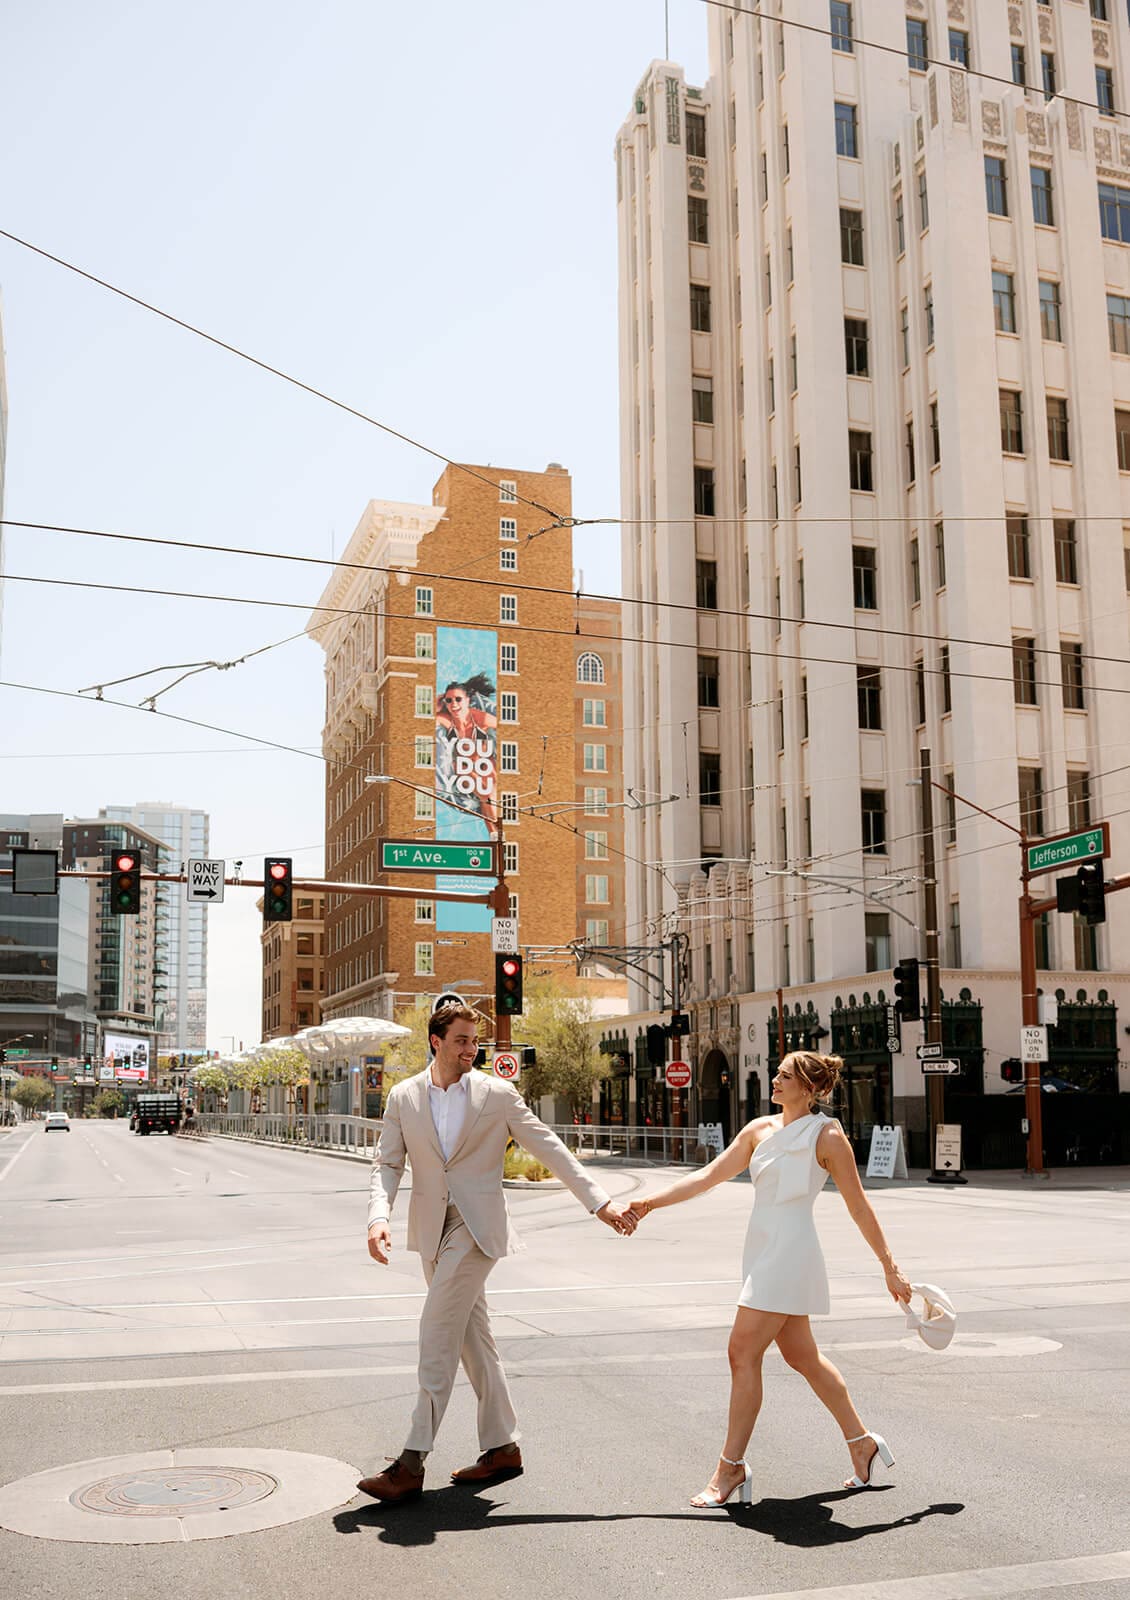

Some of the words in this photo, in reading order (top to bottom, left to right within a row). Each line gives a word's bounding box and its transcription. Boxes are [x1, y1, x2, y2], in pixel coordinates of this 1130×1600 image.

[440, 737, 493, 757] YOU
[456, 756, 493, 776] DO
[439, 774, 493, 795] YOU
[392, 849, 408, 862] 1st
[412, 850, 447, 864] Ave.
[1033, 844, 1078, 865] Jefferson
[193, 862, 219, 874] ONE
[192, 874, 220, 886] WAY
[497, 920, 512, 928] NO
